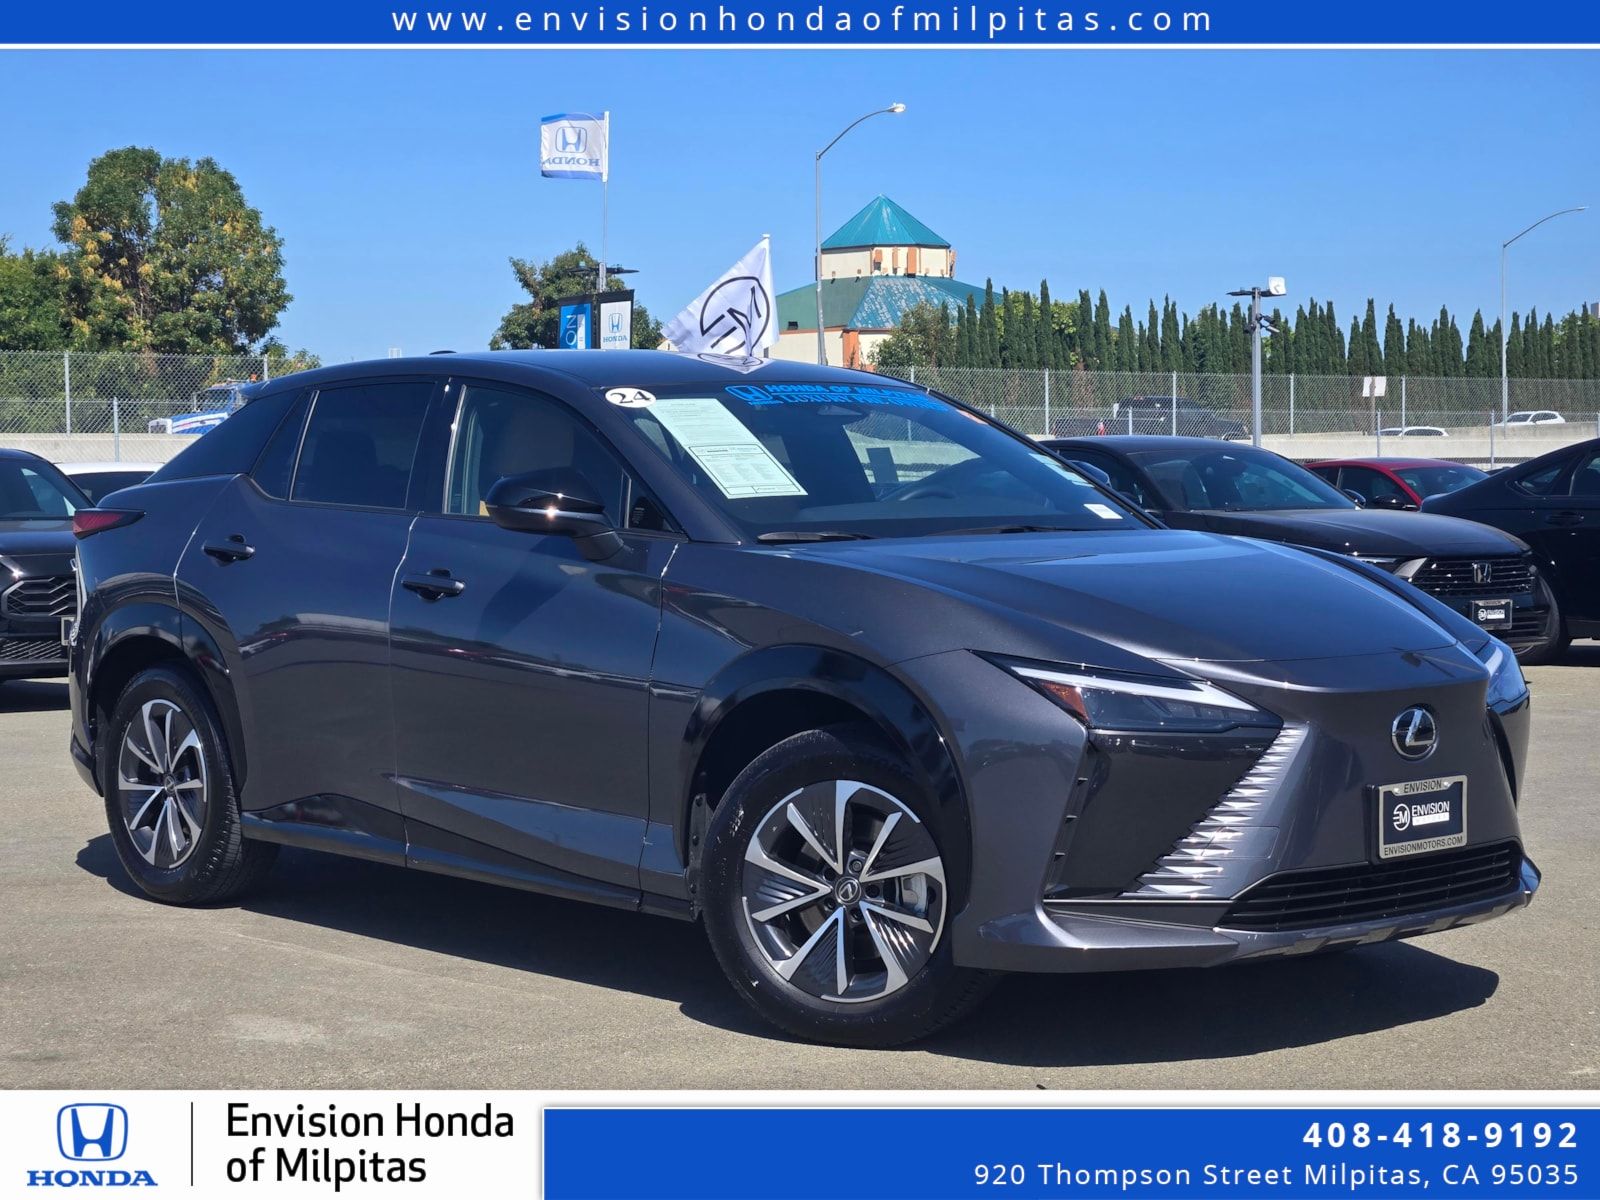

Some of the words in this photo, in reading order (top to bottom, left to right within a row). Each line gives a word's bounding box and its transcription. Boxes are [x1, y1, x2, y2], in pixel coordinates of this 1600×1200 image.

[603, 335, 628, 343] HONDA
[764, 385, 829, 393] HONDA
[610, 391, 651, 403] 24
[780, 394, 853, 403] LUXURY
[1404, 780, 1442, 793] ENVISION
[1412, 801, 1450, 816] ENVISION
[1384, 836, 1463, 856] ENVISIONMOTORS.COM
